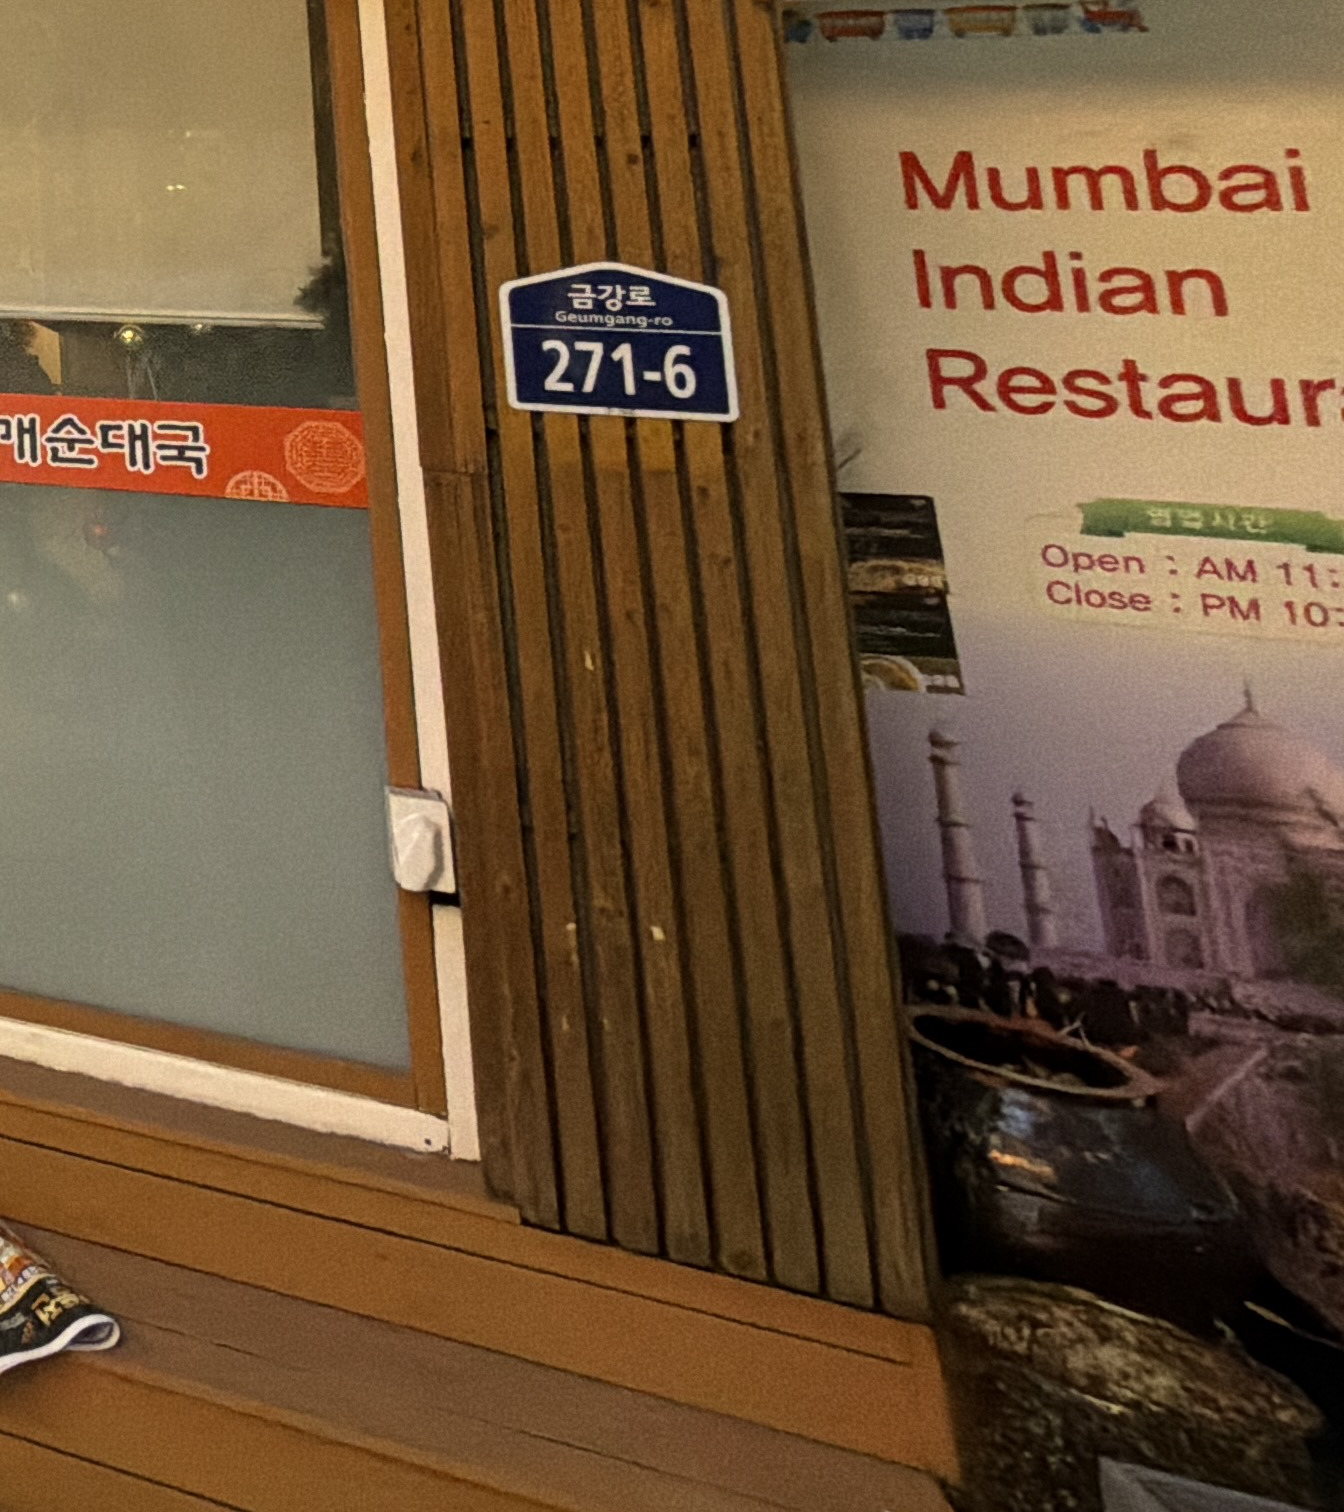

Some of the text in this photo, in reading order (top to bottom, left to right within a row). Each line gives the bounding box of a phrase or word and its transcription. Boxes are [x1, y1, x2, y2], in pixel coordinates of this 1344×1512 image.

[898, 148, 1311, 214] Mumbai
[567, 284, 656, 312] 금강로
[912, 248, 1230, 318] Indian
[555, 310, 674, 328] Geumgang-ro
[542, 339, 697, 399] 271-6
[926, 347, 1344, 428] Restaur
[1040, 543, 1146, 575] Open
[1196, 556, 1259, 584] AM
[1046, 580, 1153, 613] Close
[1200, 592, 1262, 622] PM
